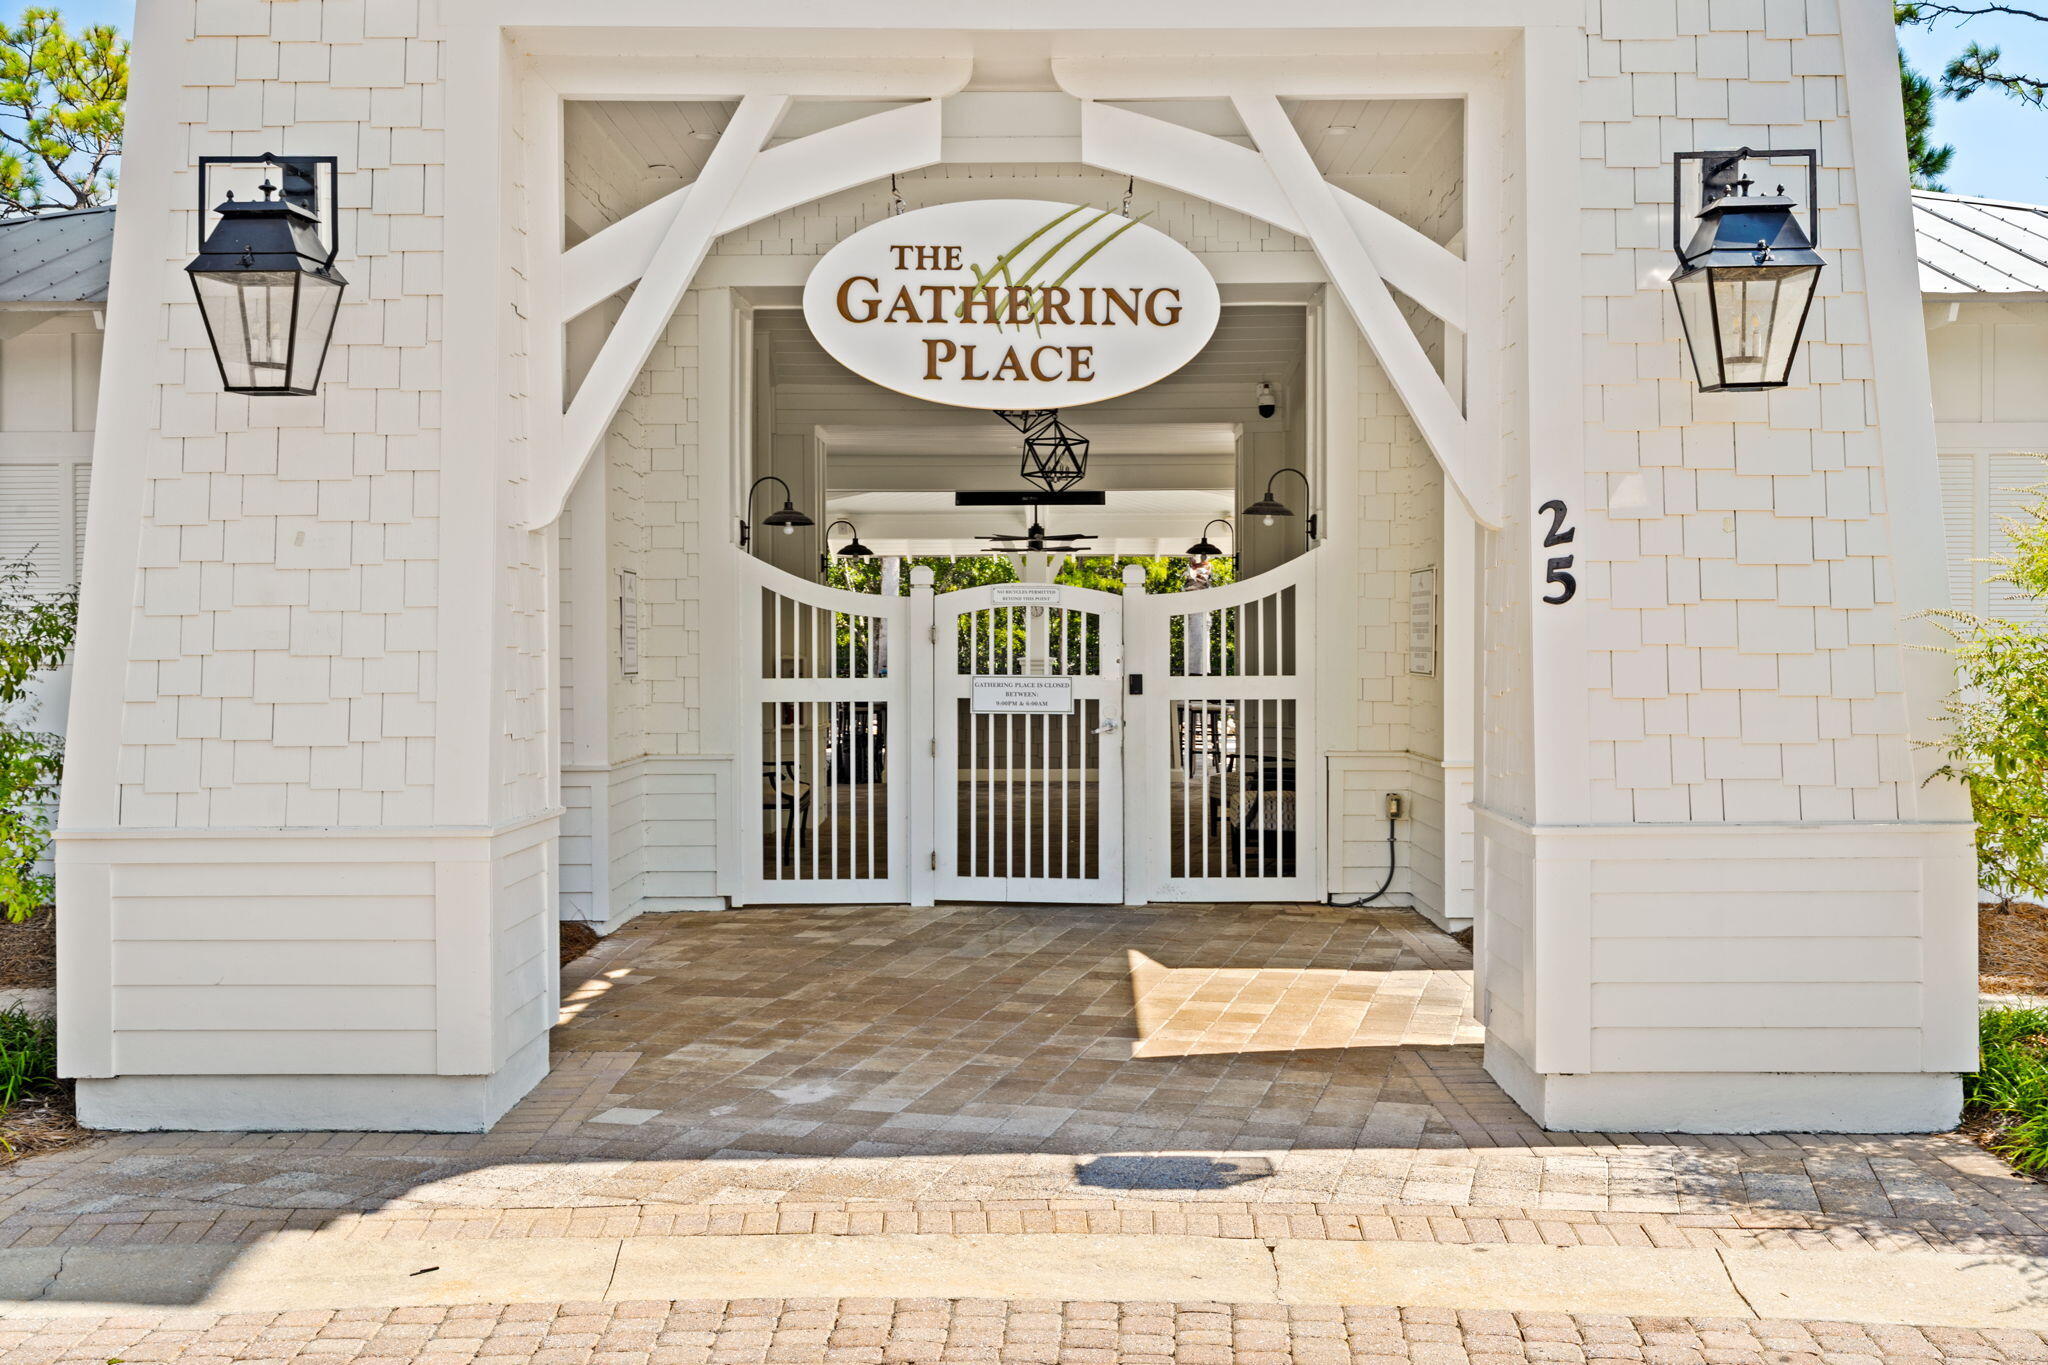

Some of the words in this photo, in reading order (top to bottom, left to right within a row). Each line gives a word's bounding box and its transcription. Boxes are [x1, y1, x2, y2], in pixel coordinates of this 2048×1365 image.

[889, 245, 963, 271] THE
[836, 276, 1183, 327] GATHERING
[922, 339, 1096, 383] PLACE
